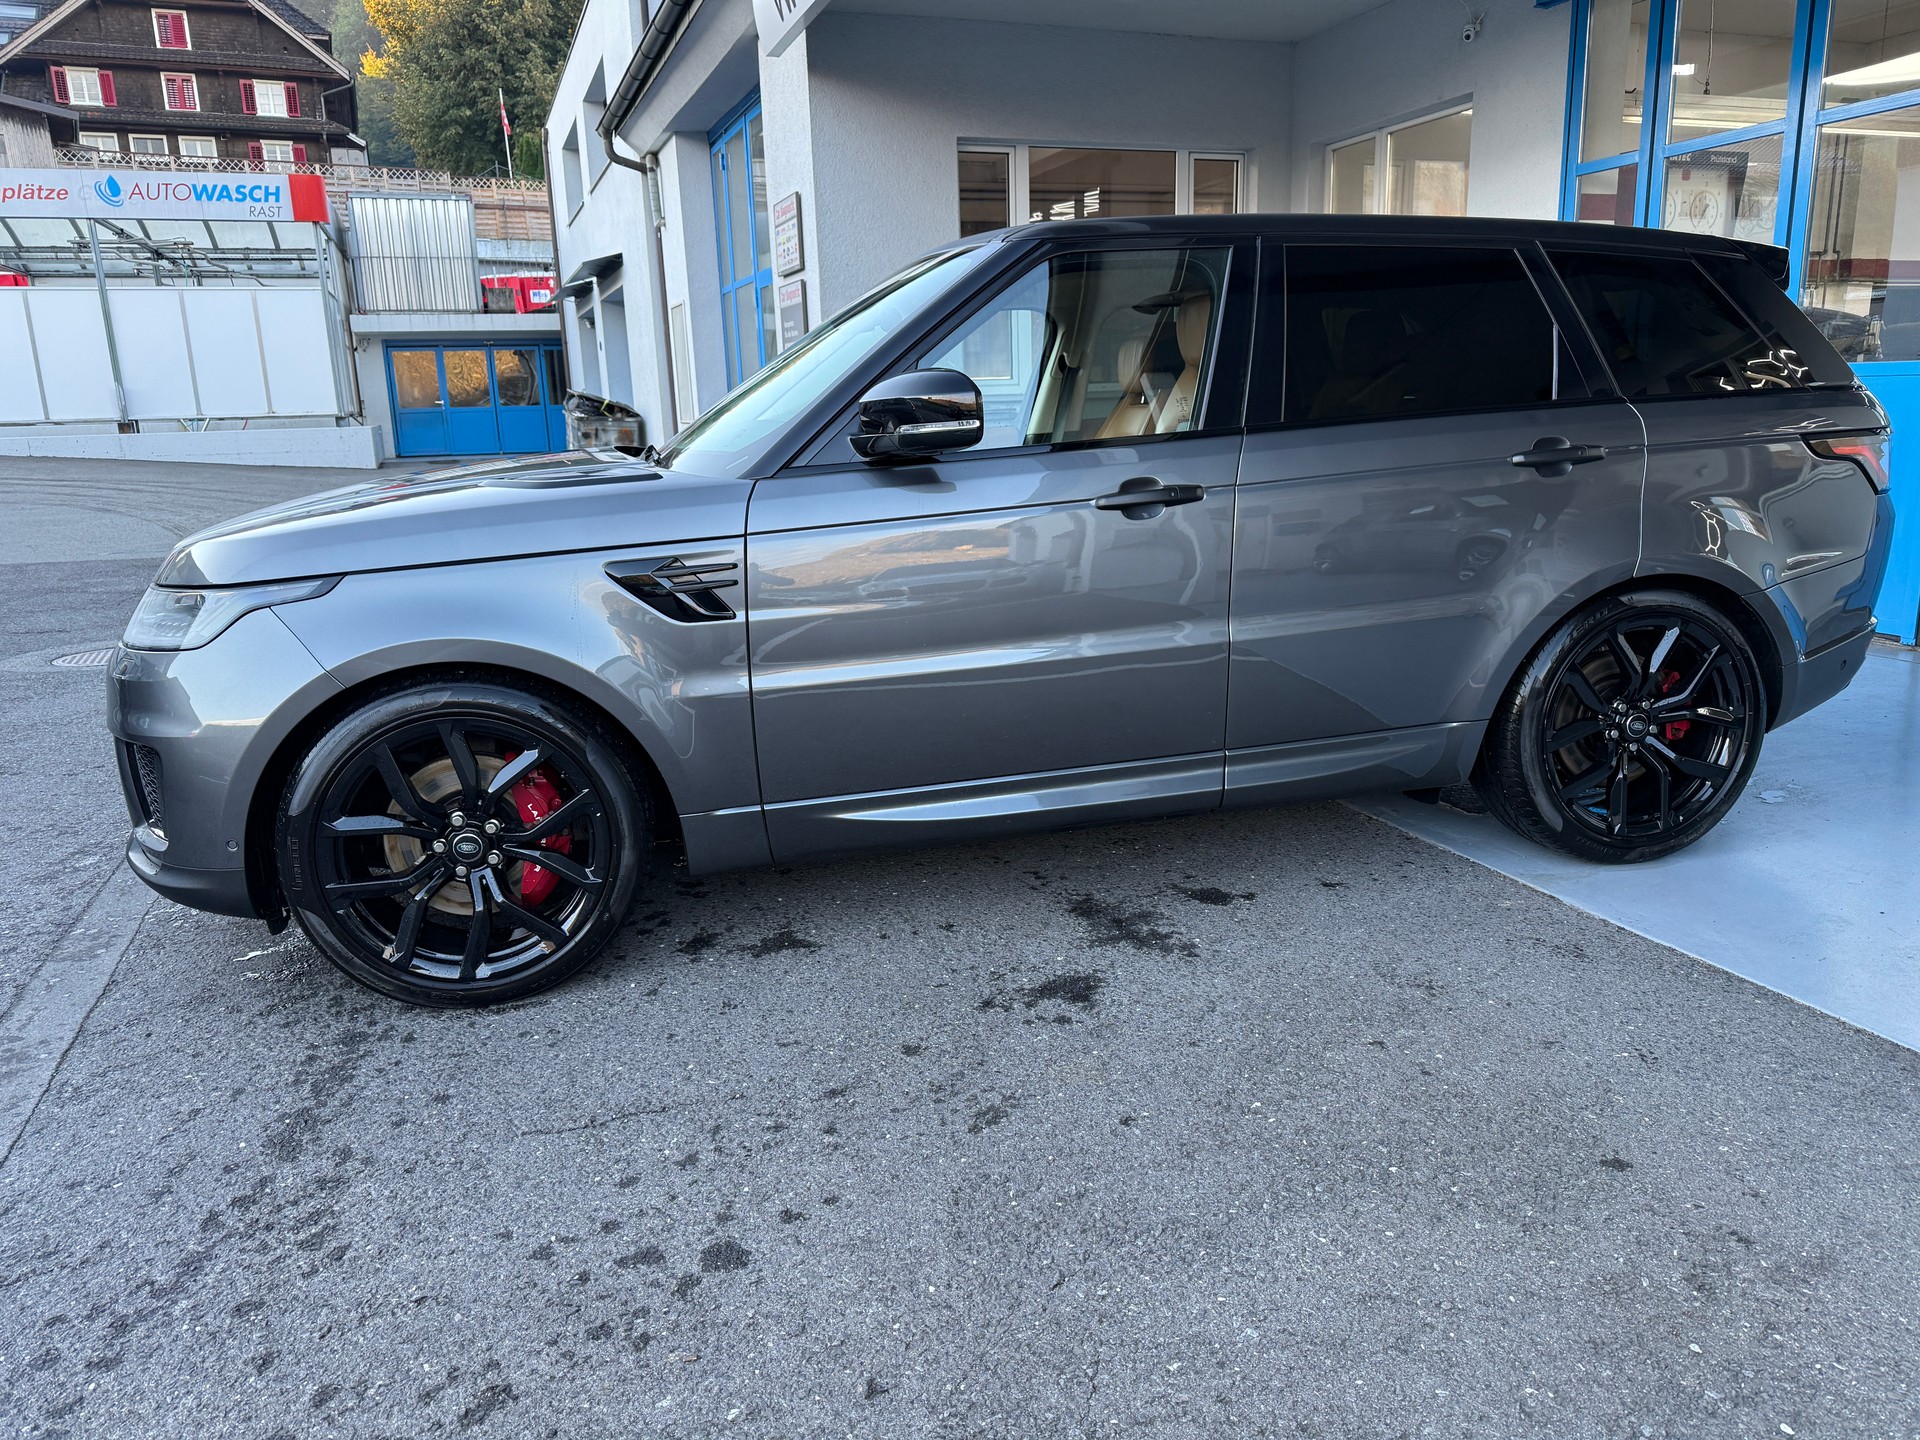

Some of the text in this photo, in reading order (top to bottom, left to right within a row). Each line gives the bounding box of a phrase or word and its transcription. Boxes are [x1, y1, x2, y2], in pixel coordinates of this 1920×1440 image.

[2, 183, 69, 203] plätze
[128, 182, 281, 203] AUTOWASCH
[249, 205, 282, 218] RAST
